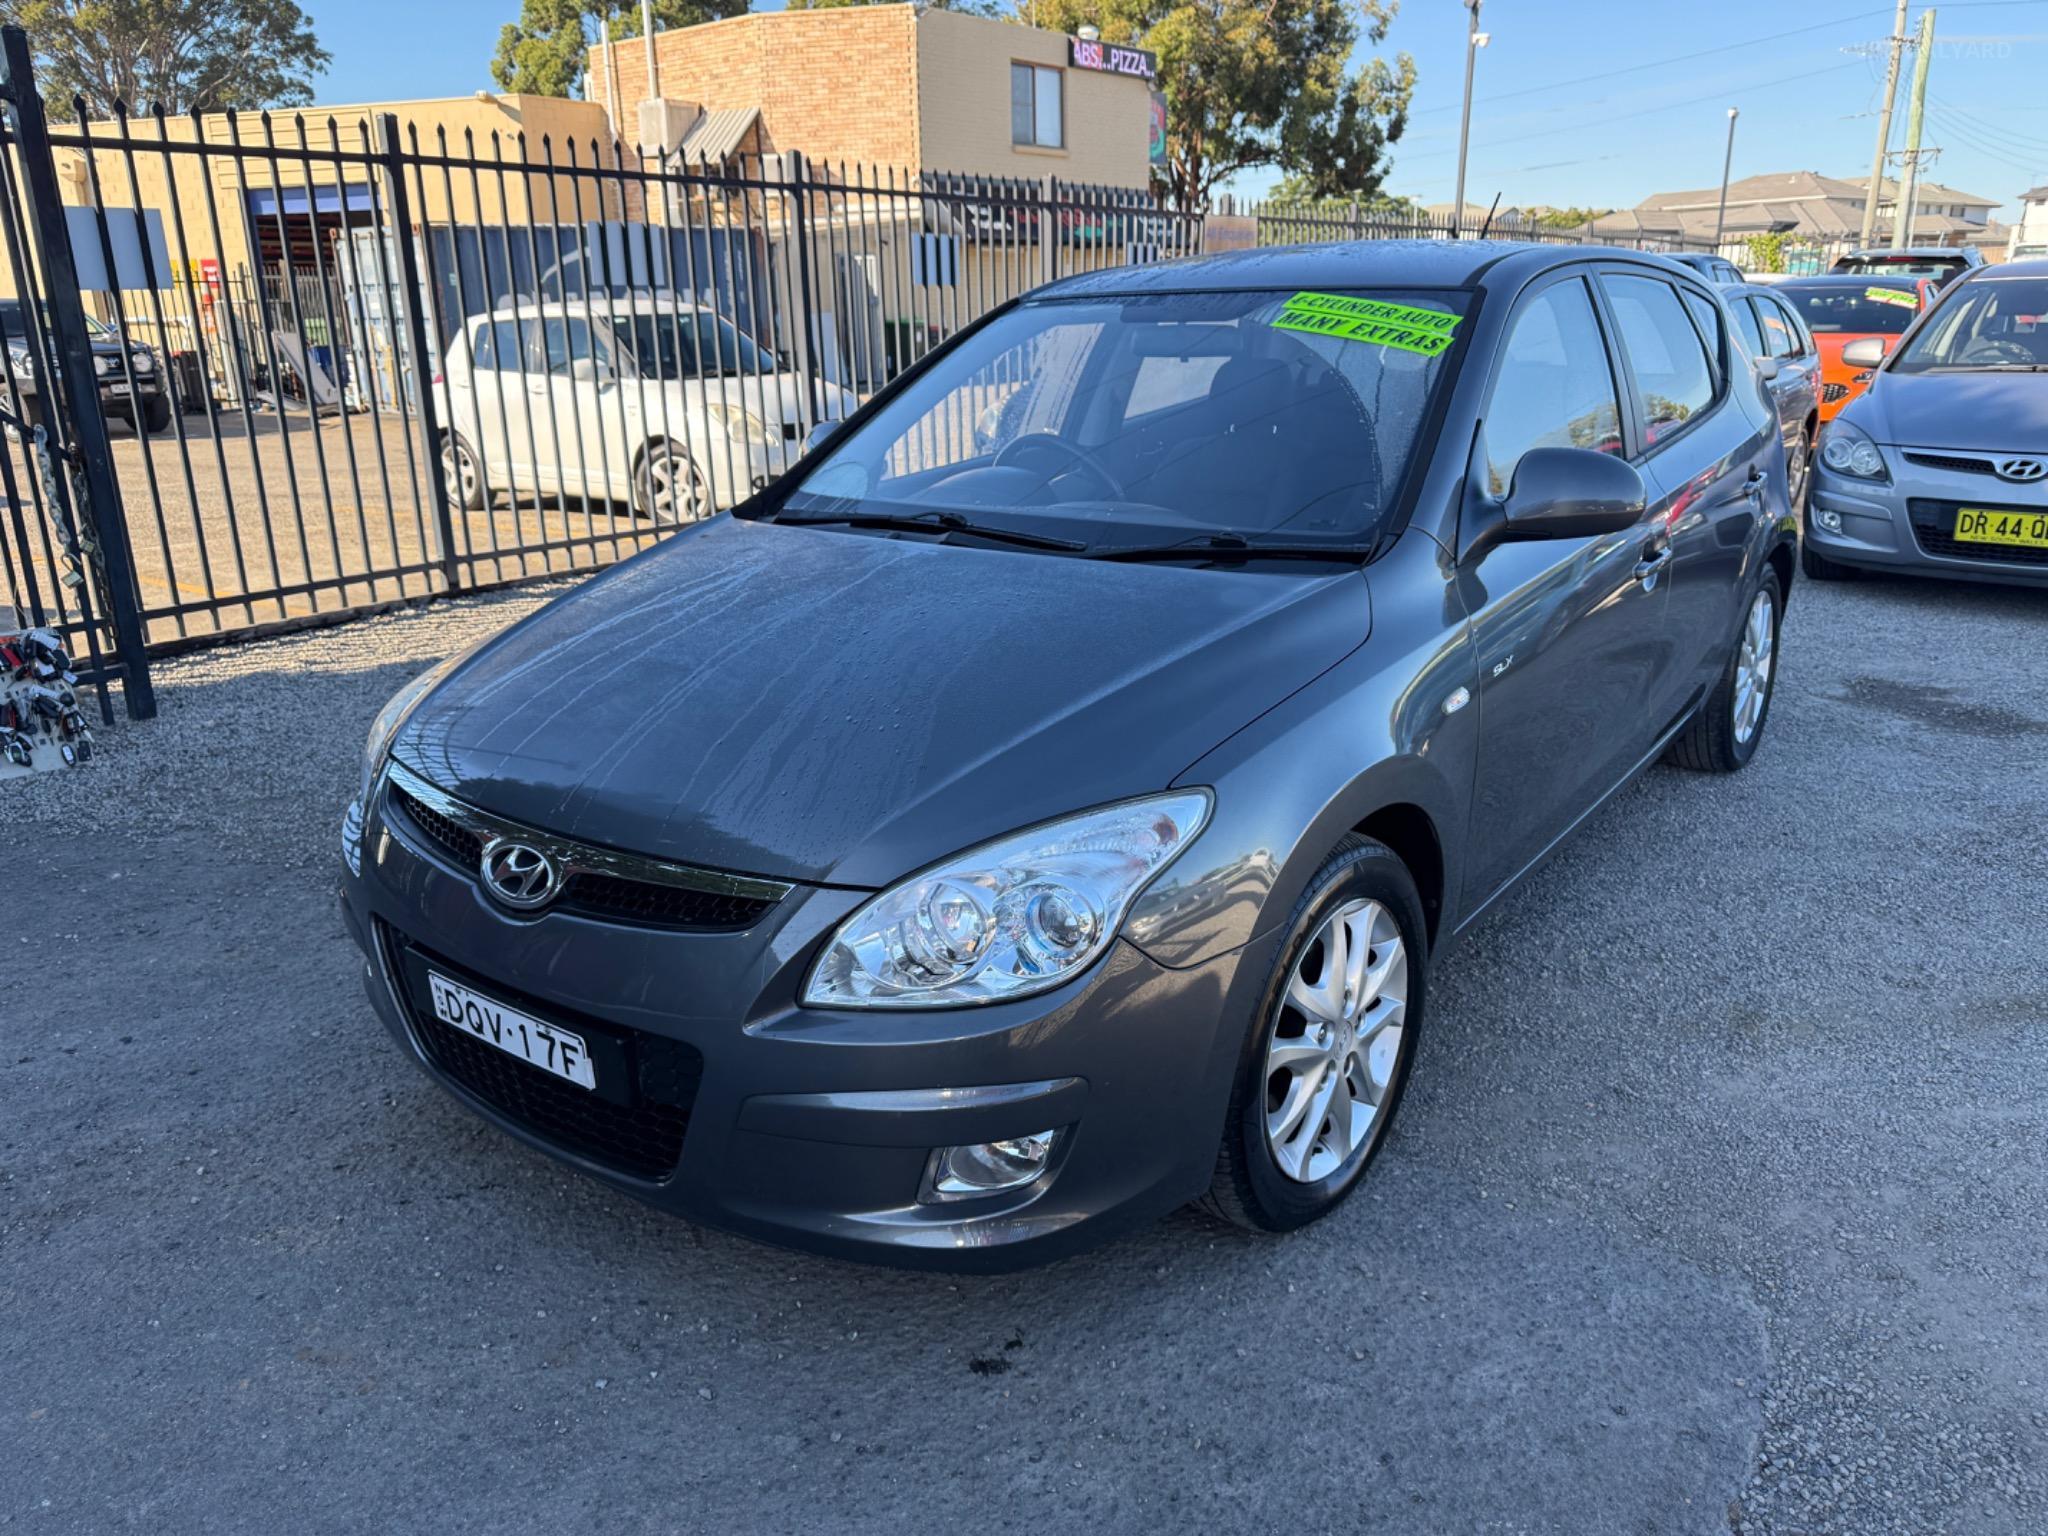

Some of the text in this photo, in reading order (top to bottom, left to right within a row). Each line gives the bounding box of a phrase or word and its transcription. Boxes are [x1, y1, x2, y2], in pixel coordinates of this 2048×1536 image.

[1281, 311, 1445, 350] MANY EXTRAS
[1395, 310, 1453, 329] AUTO
